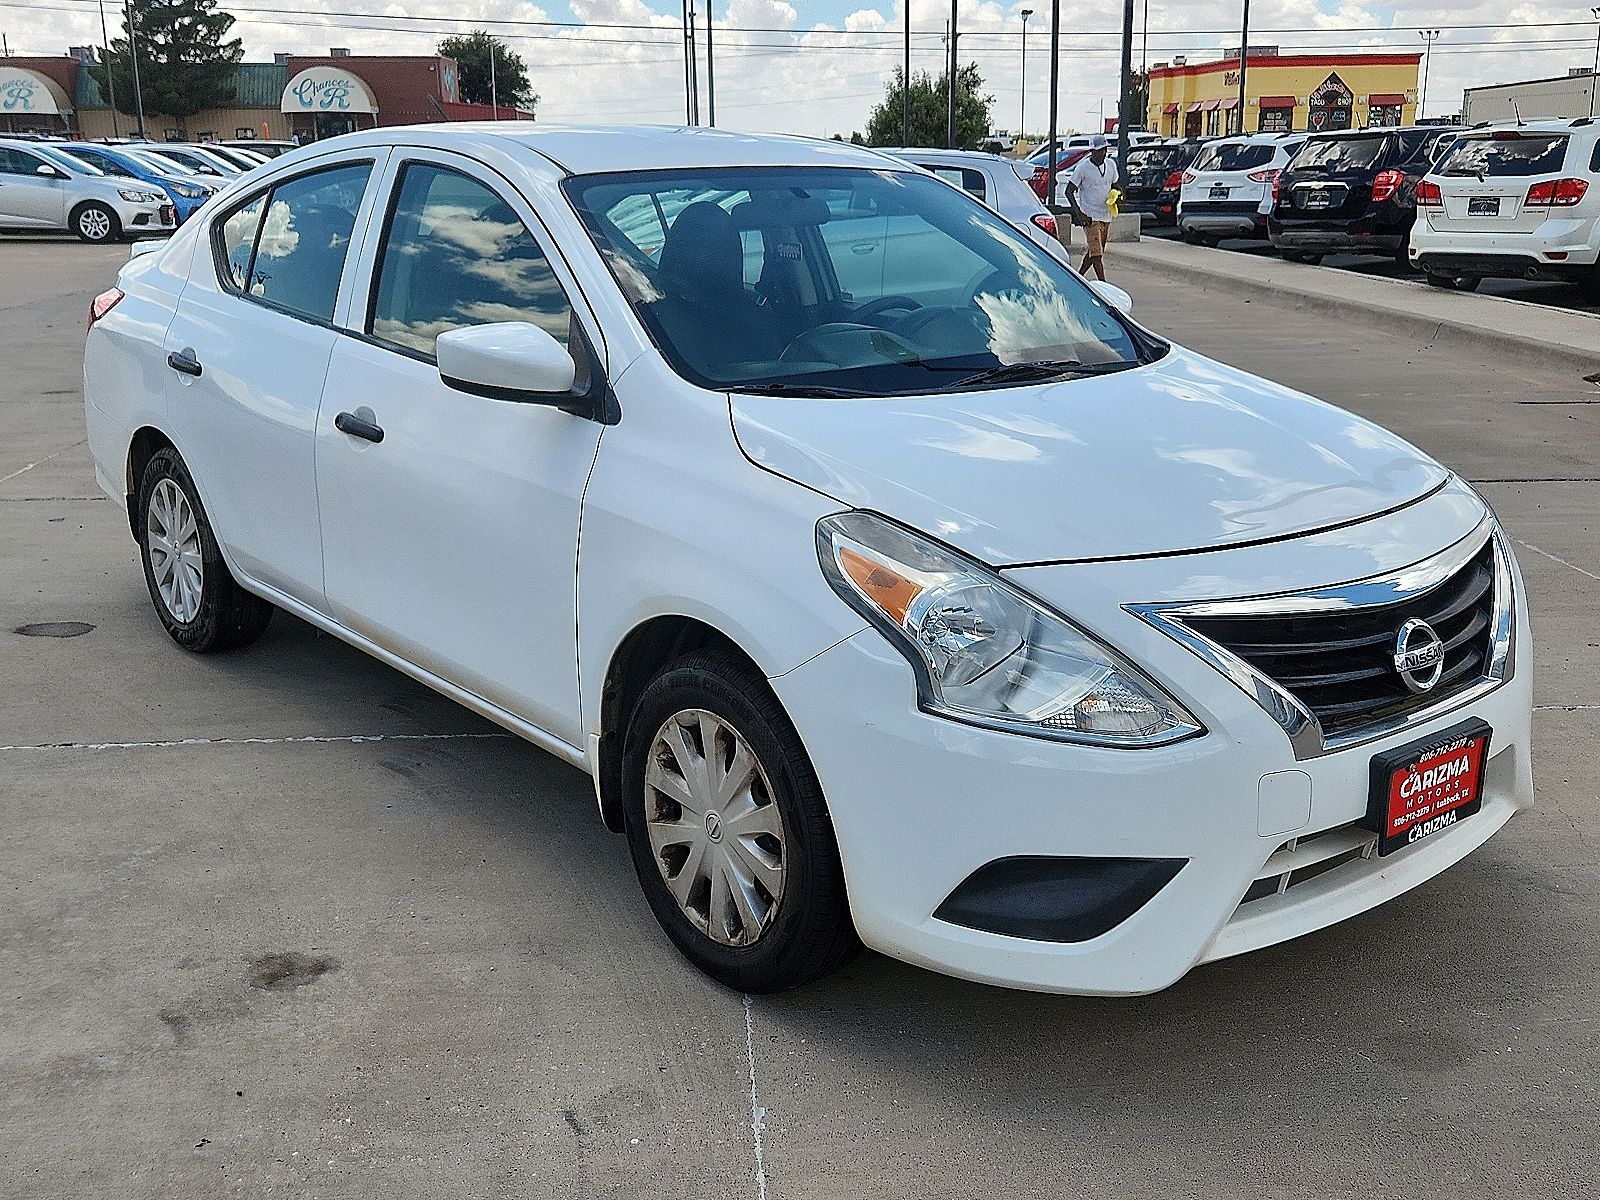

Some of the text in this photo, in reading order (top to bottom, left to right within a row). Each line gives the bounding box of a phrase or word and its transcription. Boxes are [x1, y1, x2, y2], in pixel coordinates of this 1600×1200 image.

[292, 79, 355, 108] Chances
[320, 88, 351, 109] R
[1404, 643, 1444, 668] NISSAN
[1400, 754, 1470, 799] CARIZMA
[1406, 779, 1460, 809] MOTORS
[1461, 787, 1470, 798] TX
[1408, 809, 1457, 843] CARIZMA
